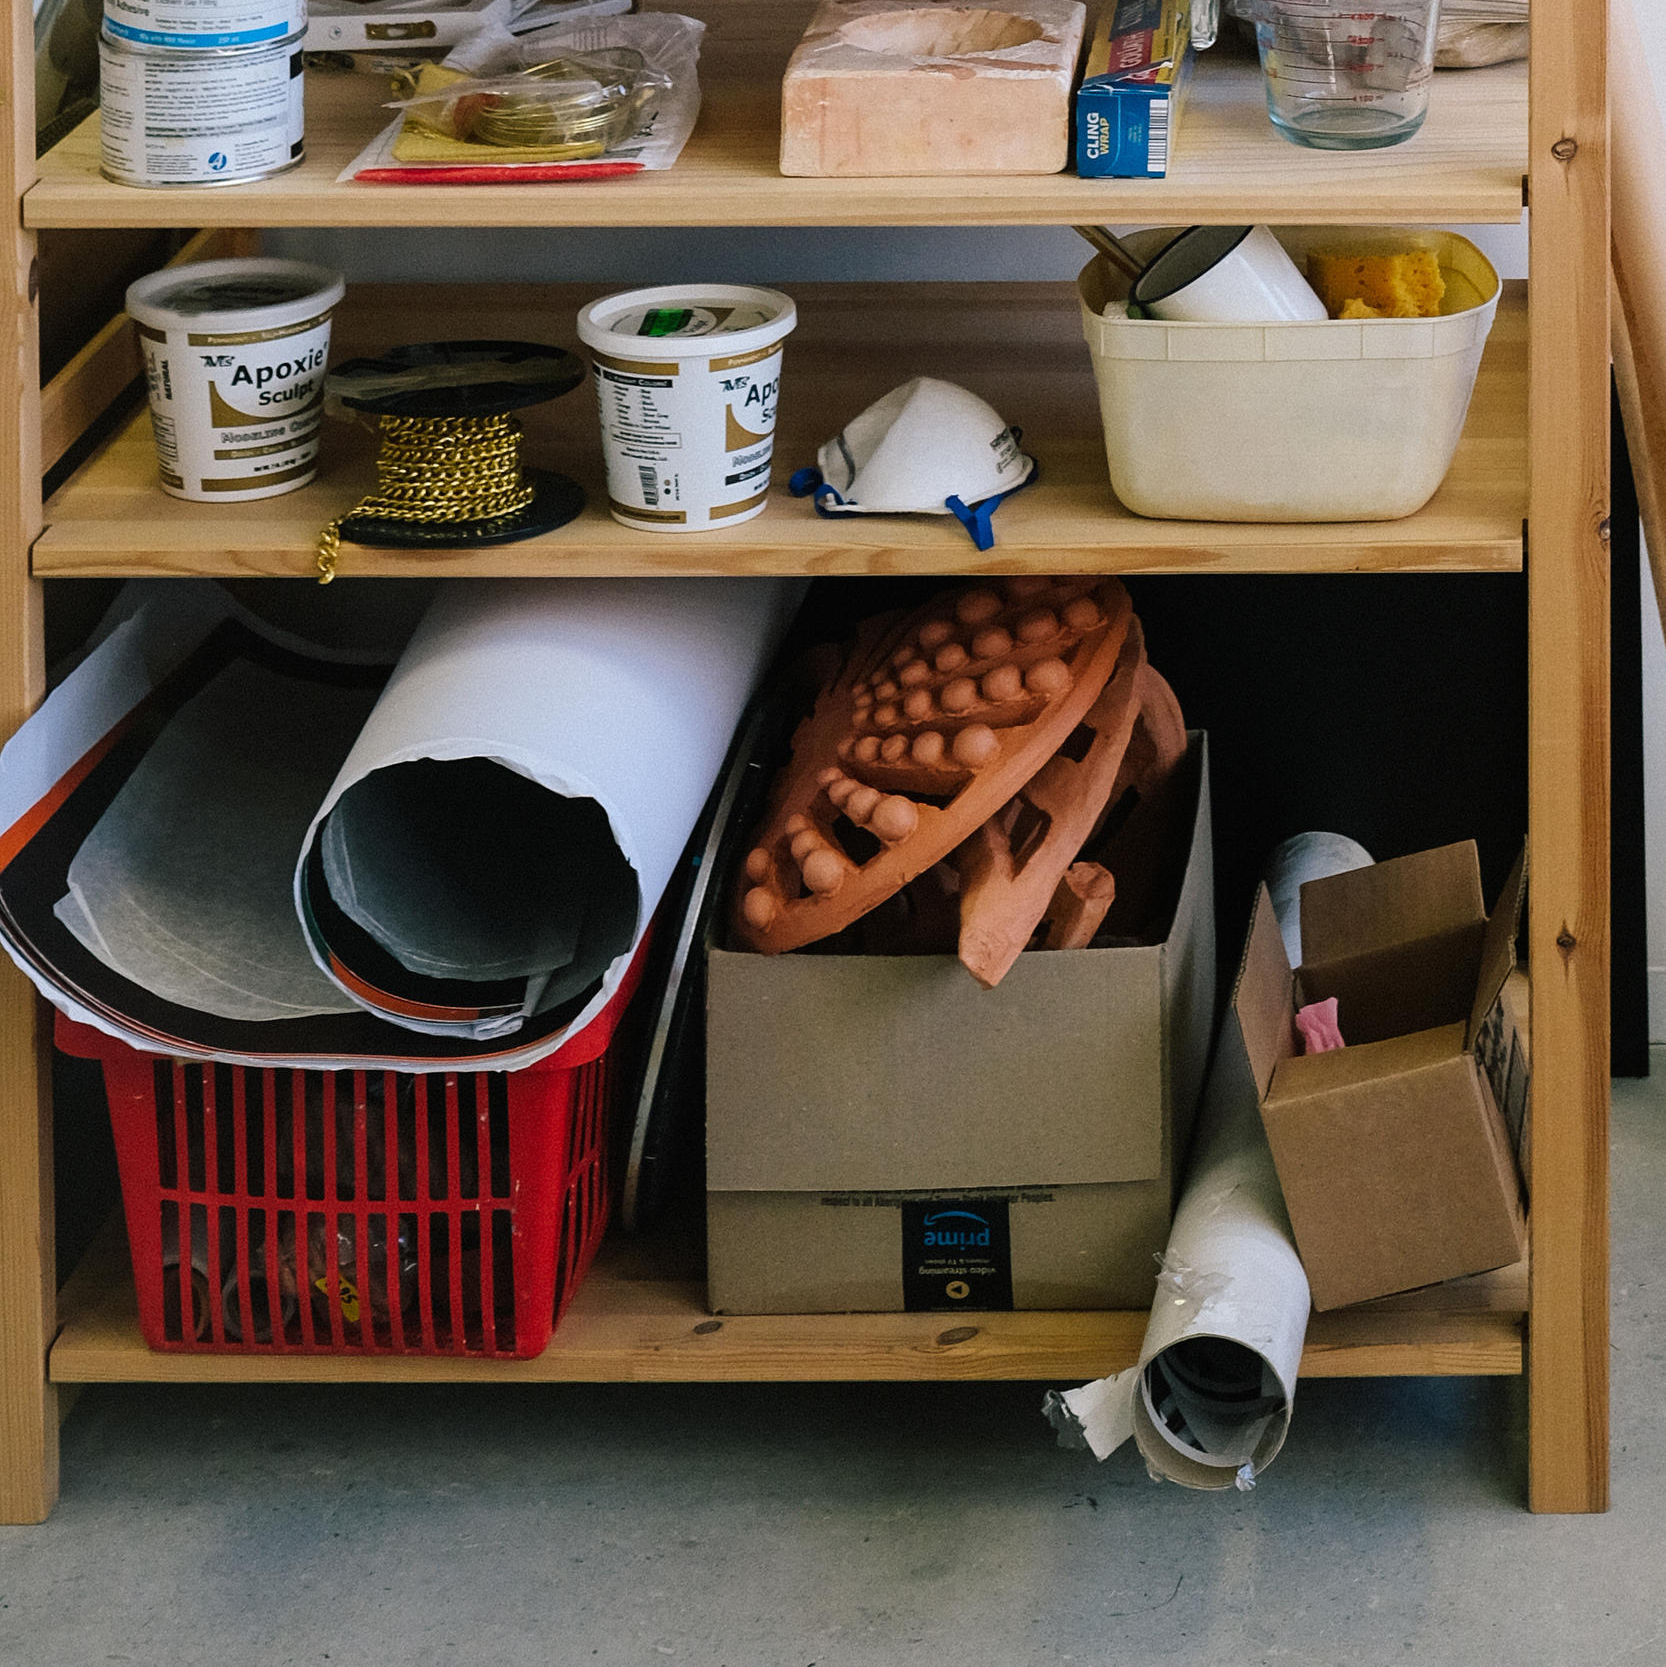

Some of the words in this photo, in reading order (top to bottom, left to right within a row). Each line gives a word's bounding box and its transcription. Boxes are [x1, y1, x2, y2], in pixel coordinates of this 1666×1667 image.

[1086, 111, 1100, 160] CLING
[1099, 117, 1110, 156] WRAP
[160, 360, 173, 401] NATURAL
[258, 379, 315, 406] Sculpt
[744, 377, 779, 407] Apo
[923, 1228, 990, 1251] prime
[918, 1266, 968, 1276] streaming
[970, 1267, 997, 1276] video
